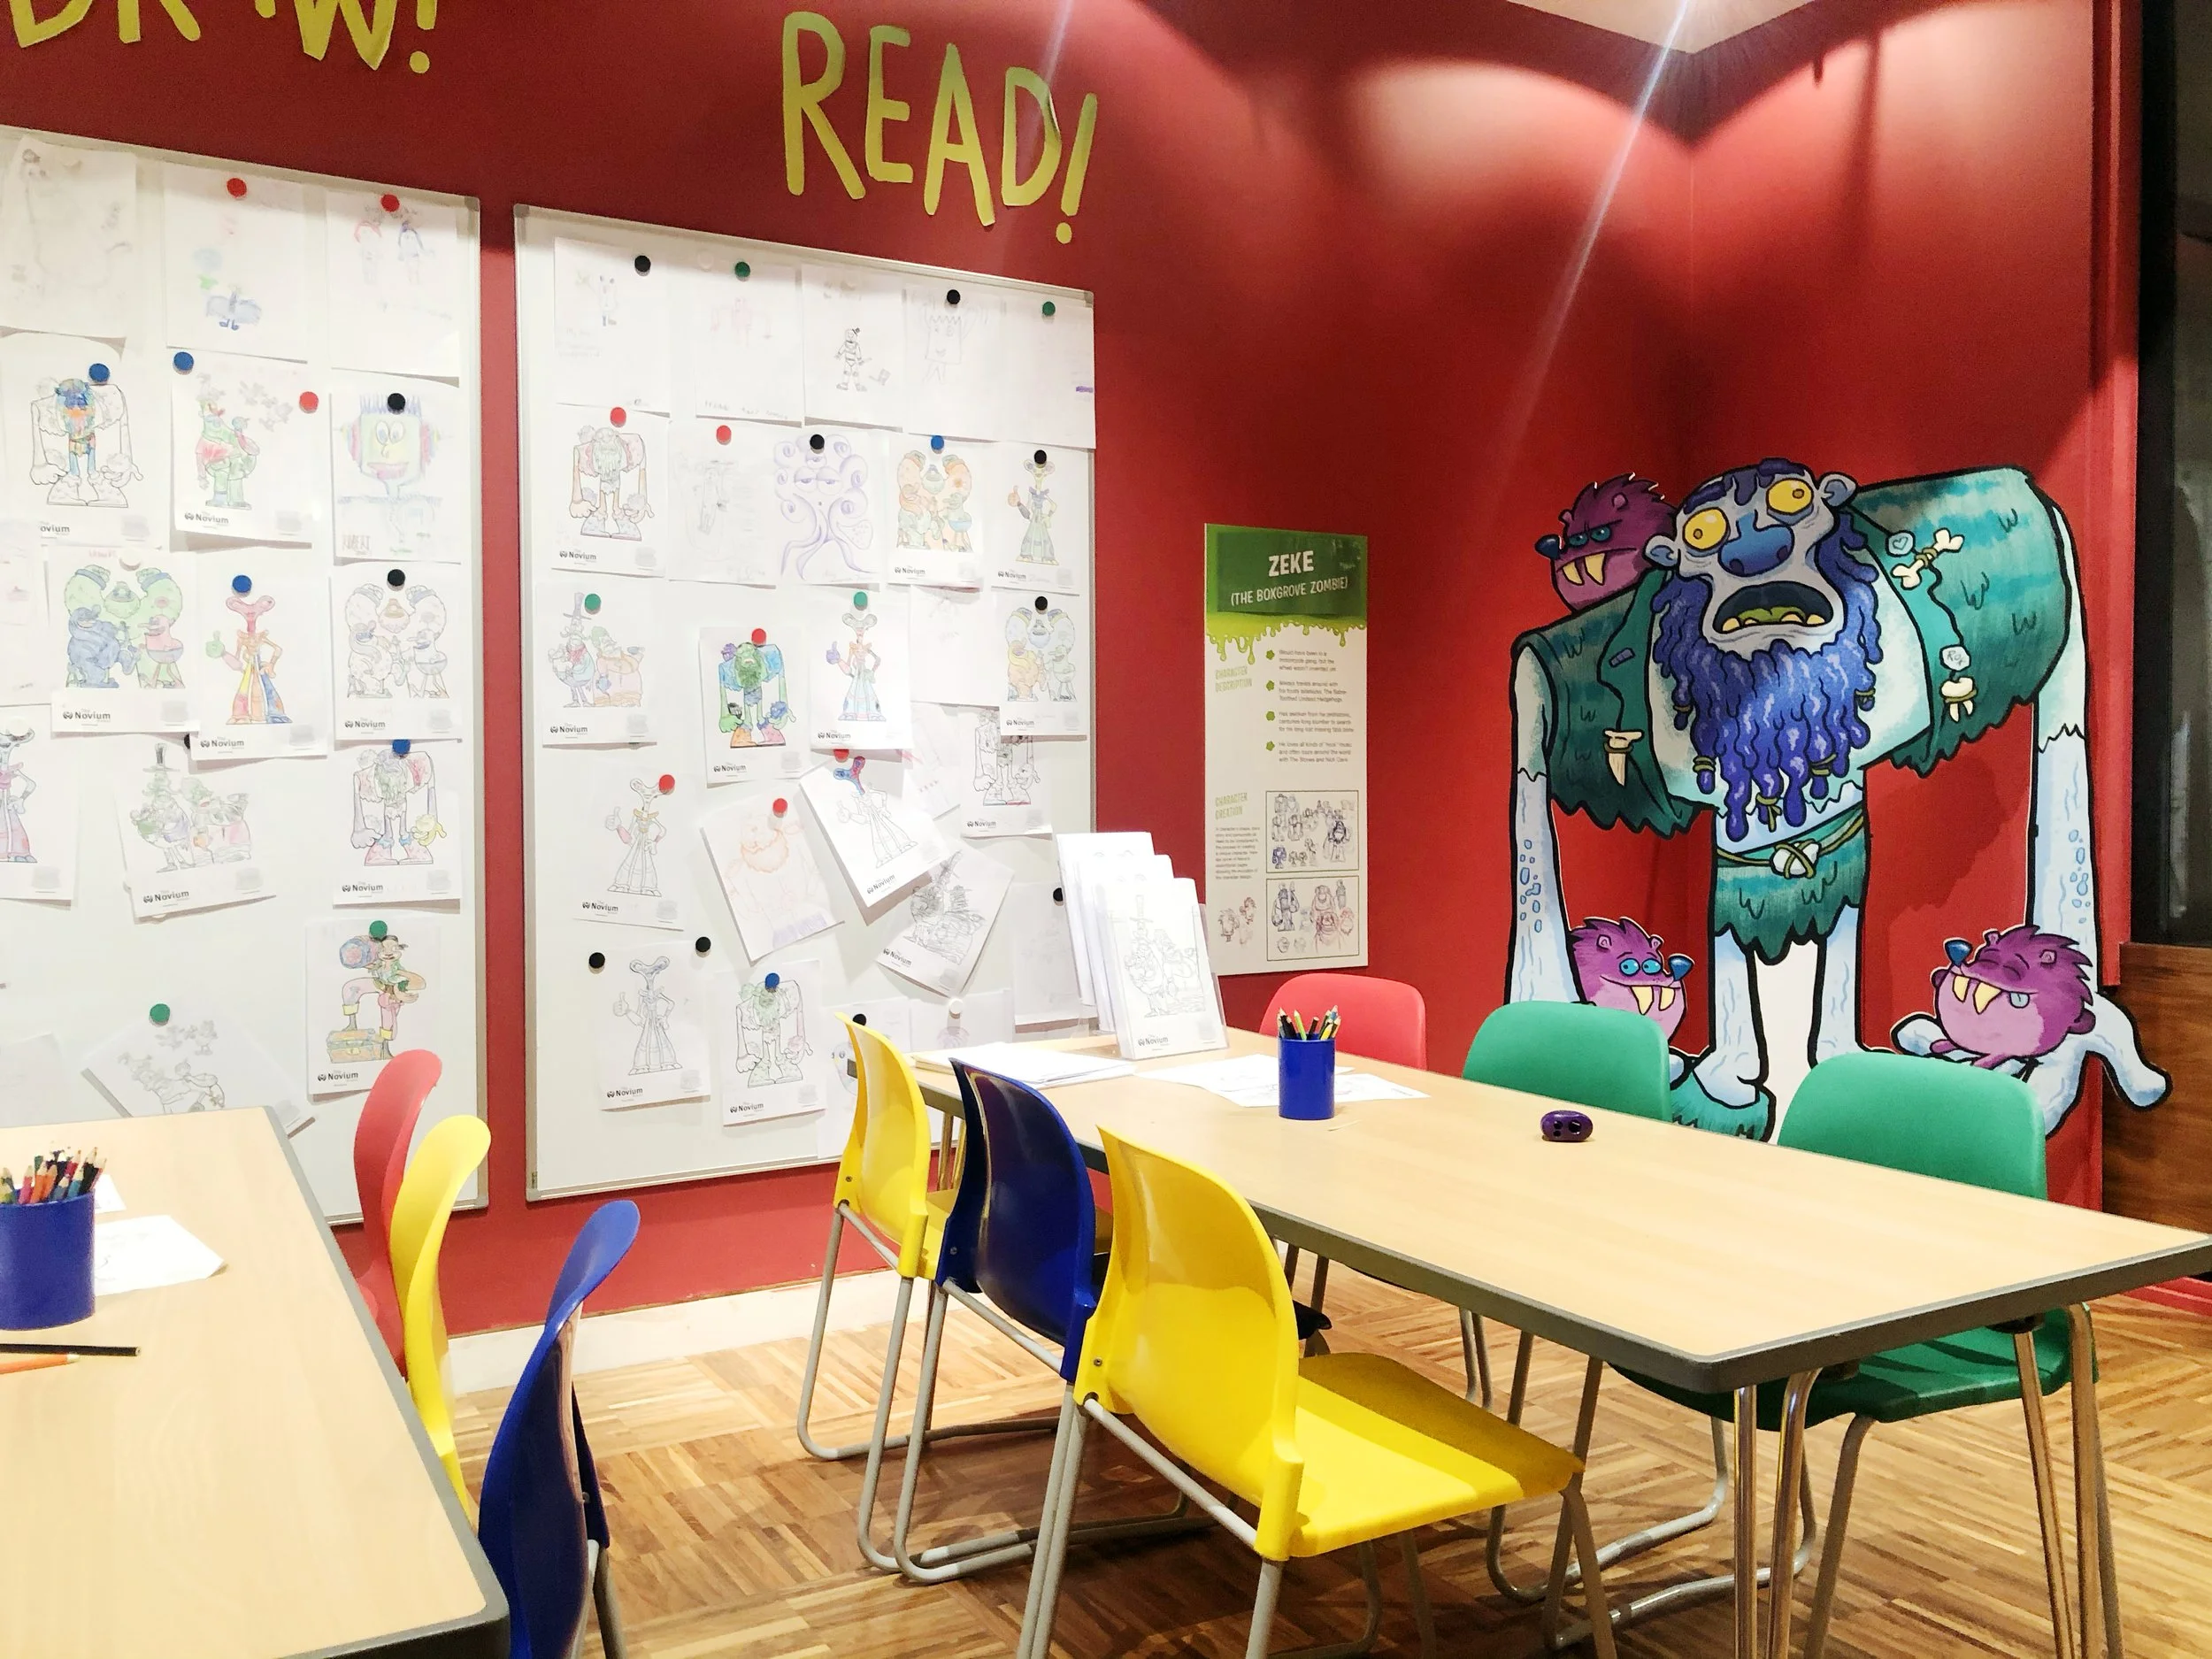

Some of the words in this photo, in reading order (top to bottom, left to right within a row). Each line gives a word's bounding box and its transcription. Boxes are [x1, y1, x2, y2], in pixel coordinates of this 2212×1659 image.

[782, 11, 1097, 244] READ!
[196, 513, 228, 523] Novium
[568, 551, 597, 560] Novium
[1268, 550, 1315, 577] ZEKE
[1231, 590, 1254, 606] (THE
[1256, 582, 1307, 603] BOXGROVE
[1310, 576, 1348, 595] ZOMBIE)
[1215, 793, 1248, 807] CHARACTER
[1215, 806, 1243, 820] CREATION
[872, 874, 895, 889] Novium
[154, 891, 189, 901] Novium
[591, 902, 618, 911] Novium
[1144, 1036, 1169, 1045] Novium
[328, 1071, 358, 1080] Novium
[615, 1088, 643, 1097] Novium
[738, 1103, 764, 1112] Novium
